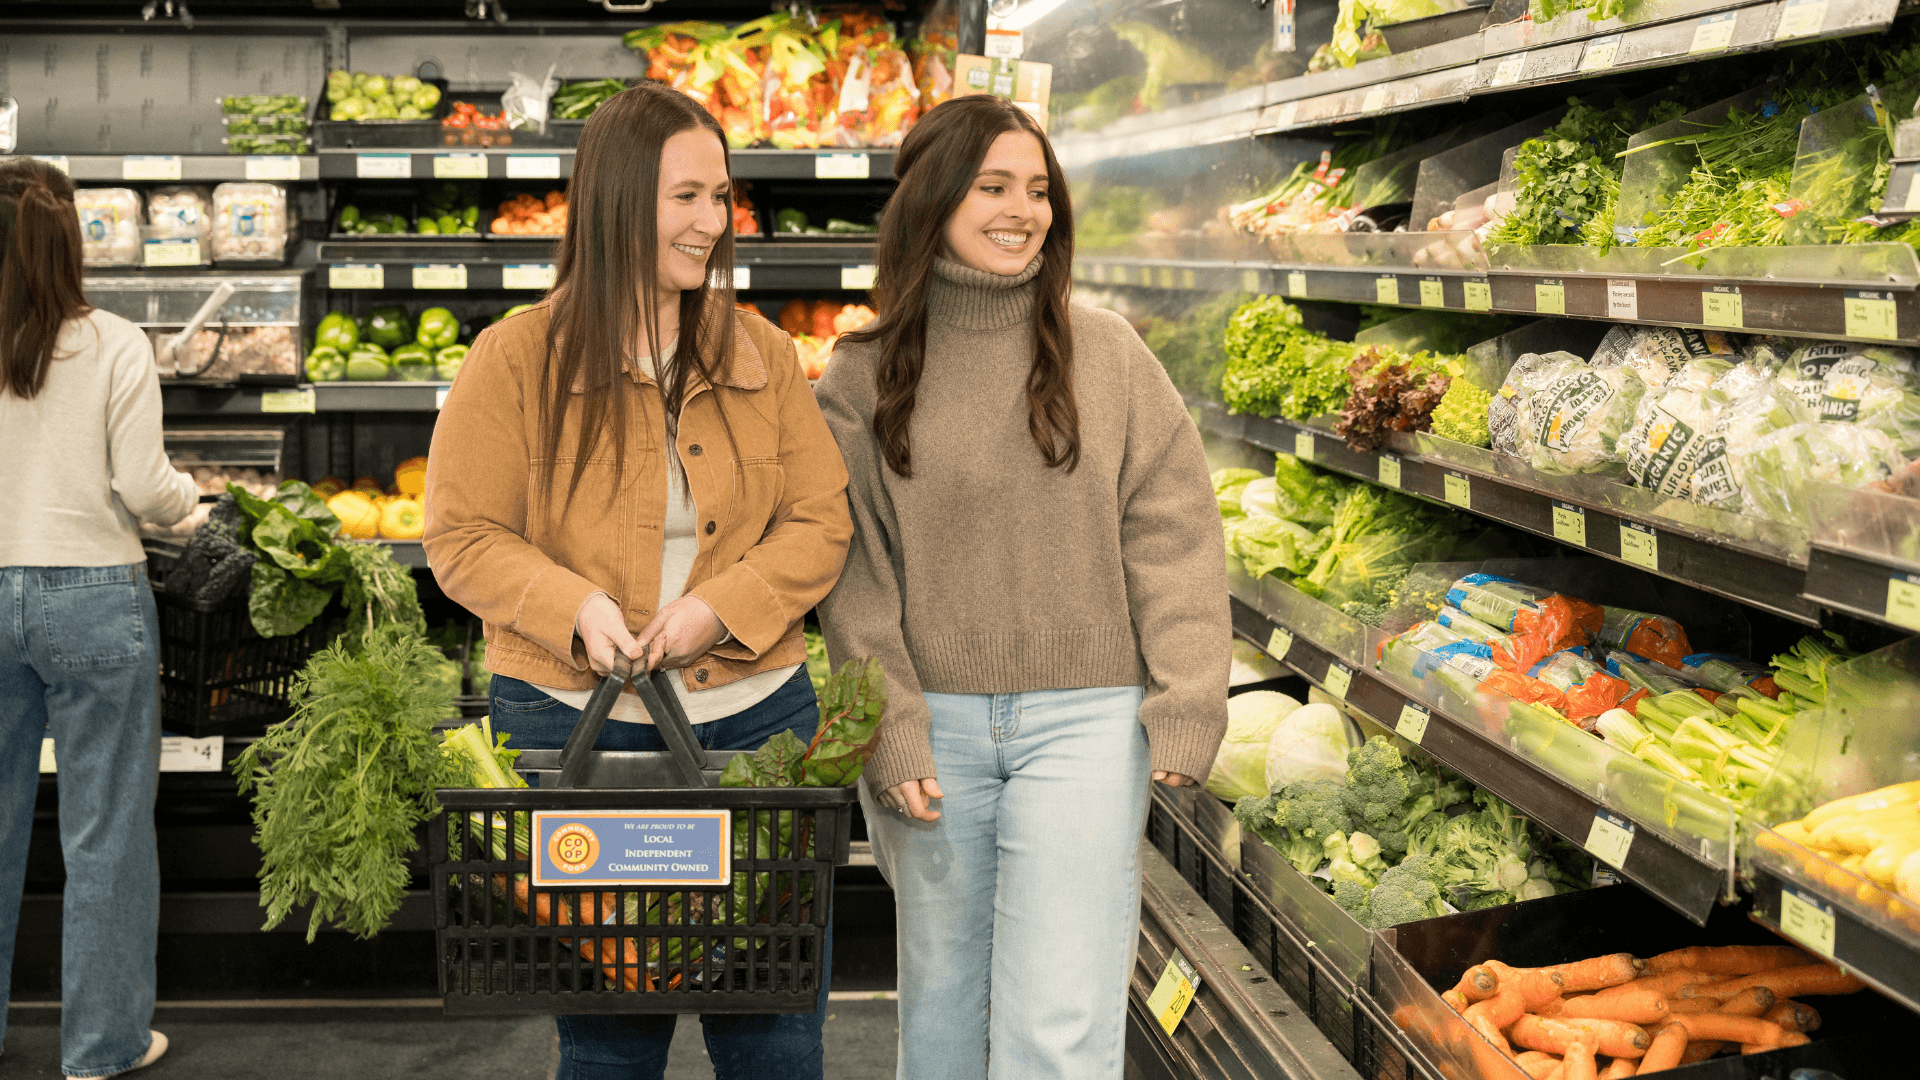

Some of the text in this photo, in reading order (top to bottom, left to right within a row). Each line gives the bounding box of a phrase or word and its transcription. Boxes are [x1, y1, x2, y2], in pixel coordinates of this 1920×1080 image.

[1809, 346, 1847, 357] Farm
[202, 745, 211, 760] 4
[553, 826, 595, 842] COMMUNITY
[644, 835, 674, 843] LOCAL
[624, 849, 693, 857] INDEPENDENT
[608, 863, 709, 872] COMMUNITY OWNED
